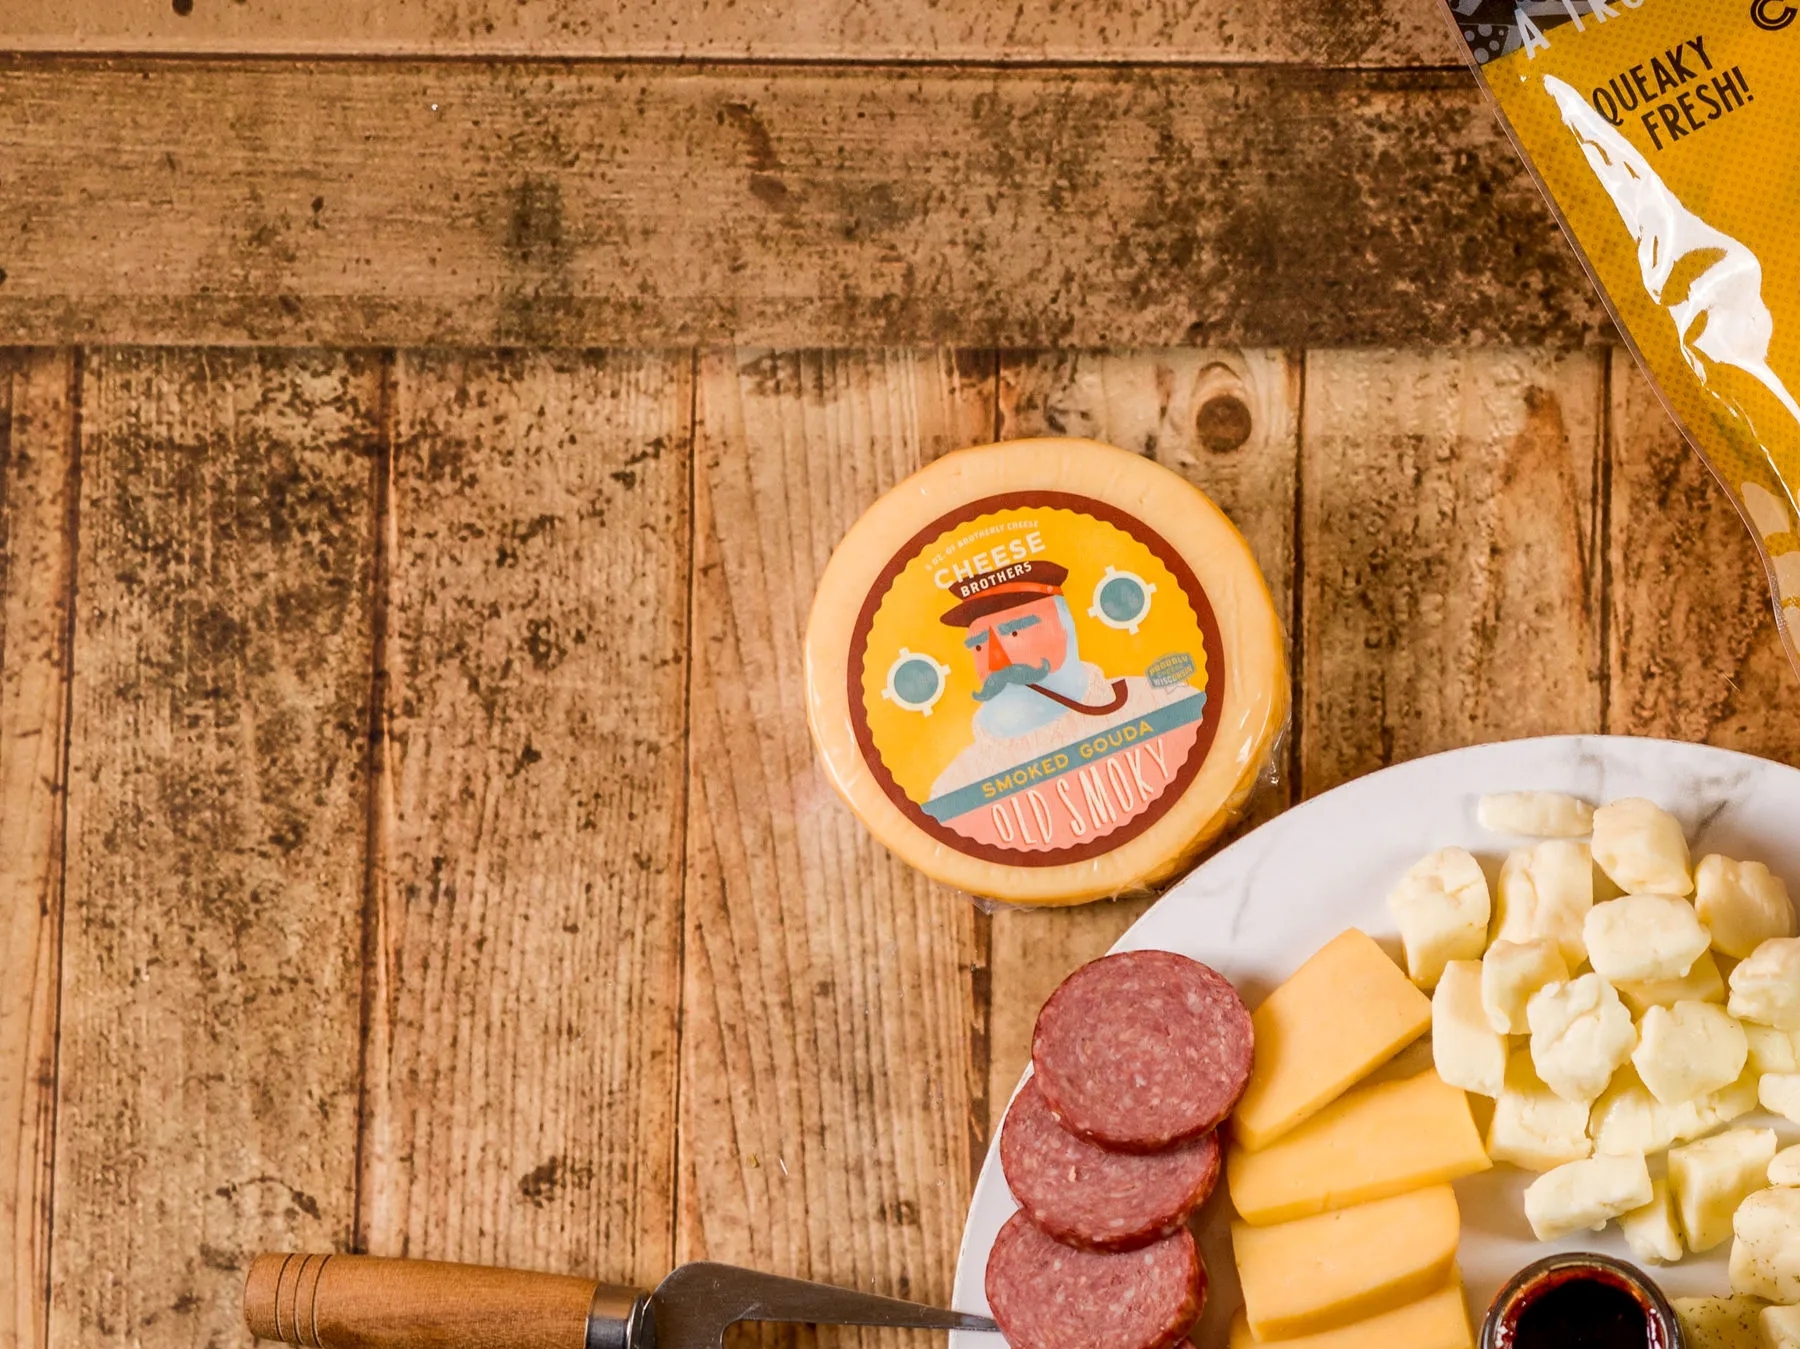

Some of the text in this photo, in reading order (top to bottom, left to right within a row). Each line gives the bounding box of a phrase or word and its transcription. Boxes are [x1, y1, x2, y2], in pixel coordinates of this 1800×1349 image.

[1592, 35, 1713, 127] QUEAKY
[1641, 66, 1754, 151] FRESH!
[933, 531, 1046, 590] CHEESE
[957, 524, 1005, 548] BROTHERLY
[1007, 520, 1040, 531] CHEESE
[960, 561, 1033, 598] BROTHERS
[982, 719, 1154, 799] SMOKED GOUDA
[992, 737, 1170, 845] OLD SMOKY
